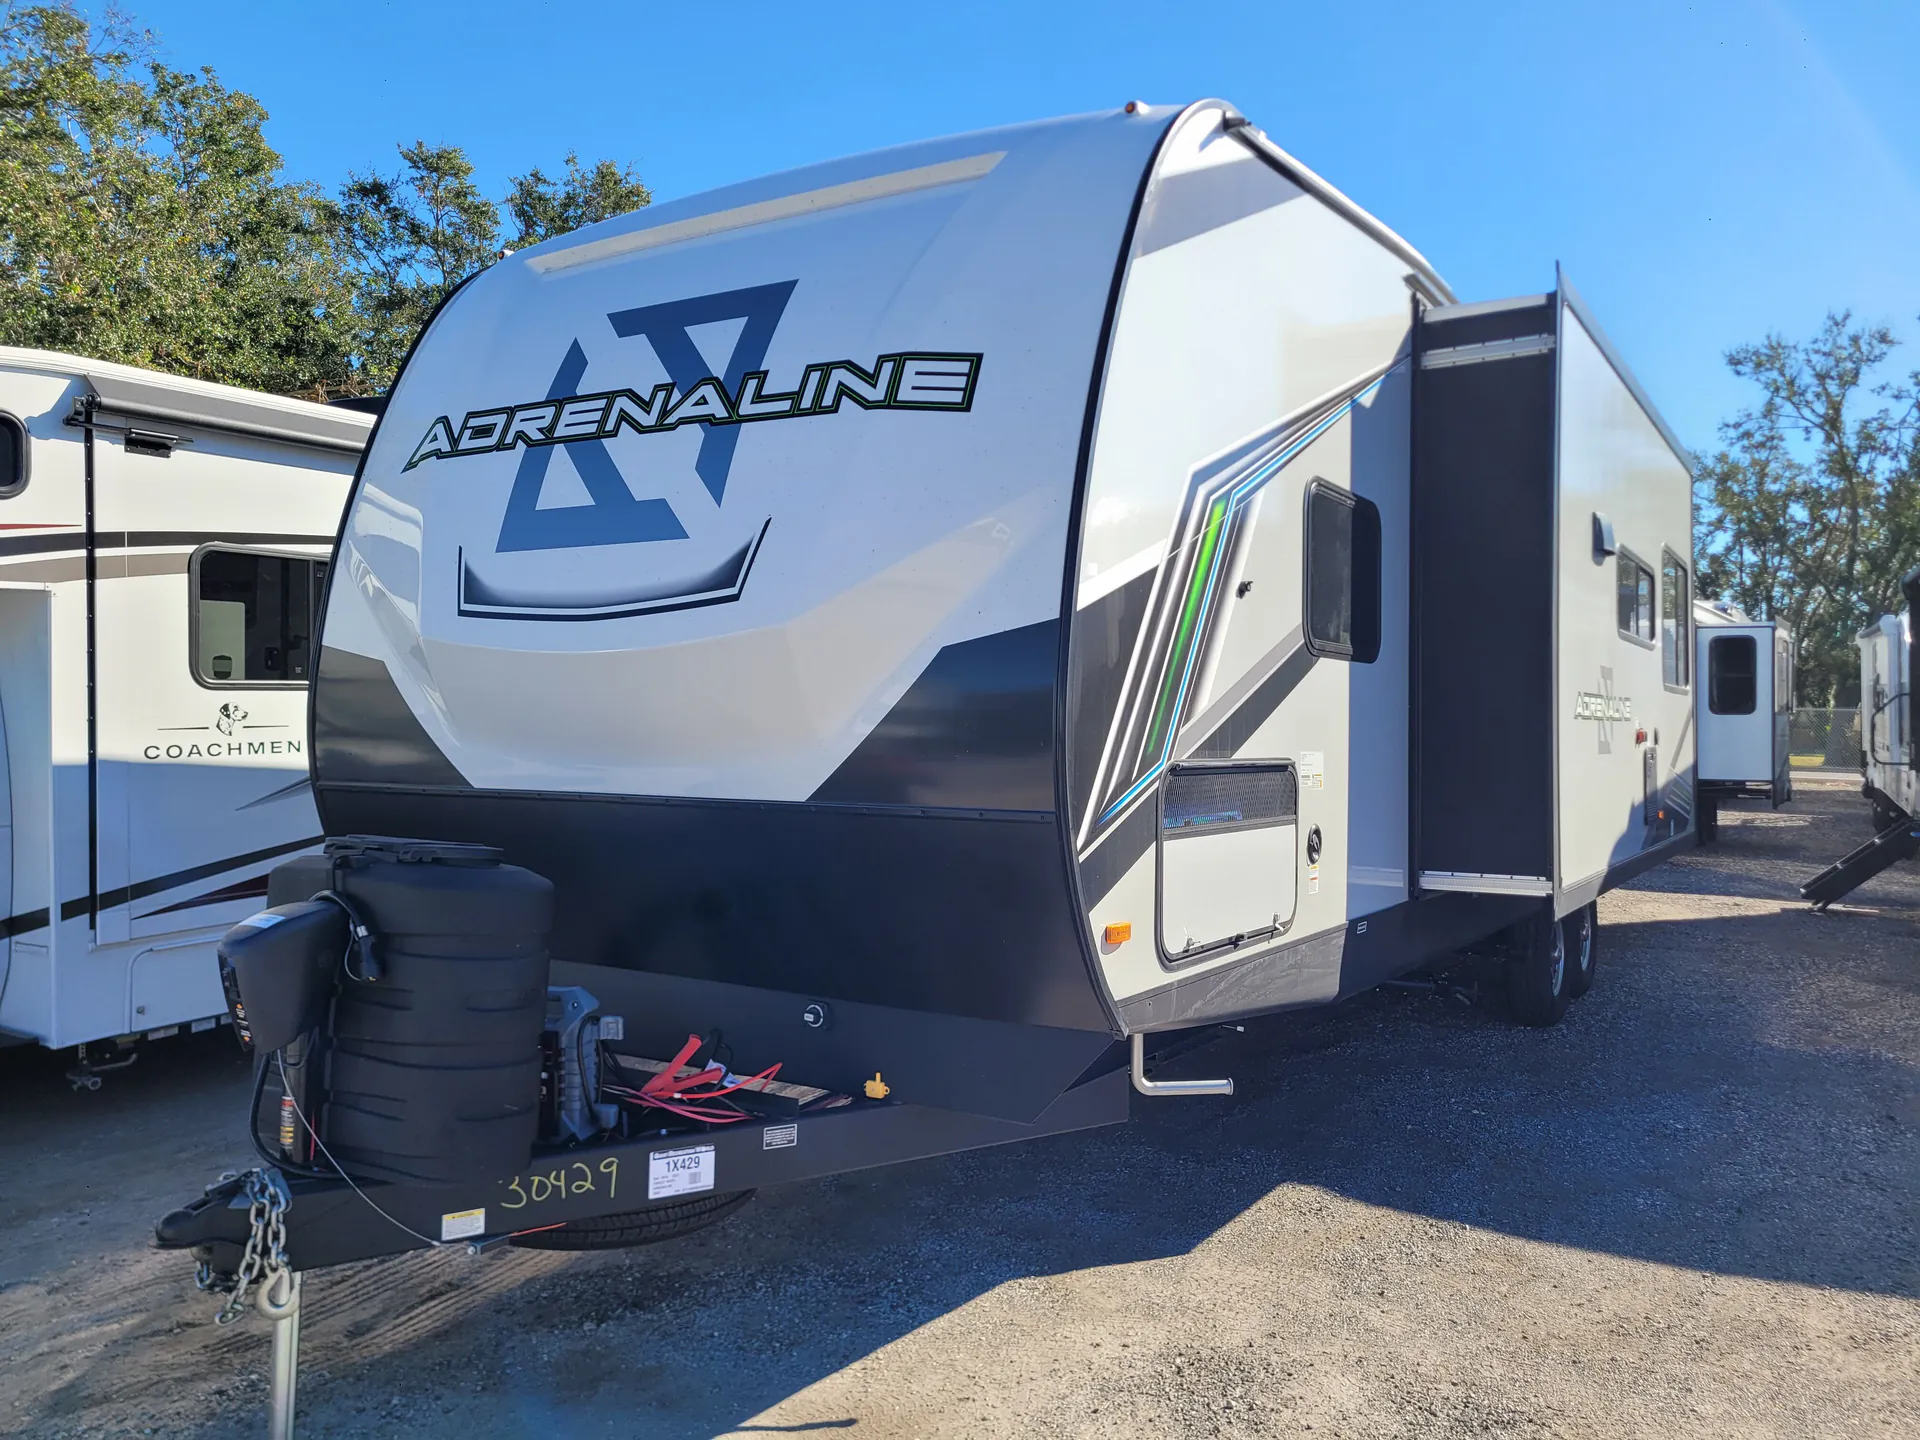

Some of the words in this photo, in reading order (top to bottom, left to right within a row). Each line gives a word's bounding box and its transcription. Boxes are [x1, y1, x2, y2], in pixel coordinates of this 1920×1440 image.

[400, 352, 984, 474] ADRENALINE
[144, 740, 301, 760] COACHMEN
[665, 1156, 701, 1173] 1X429
